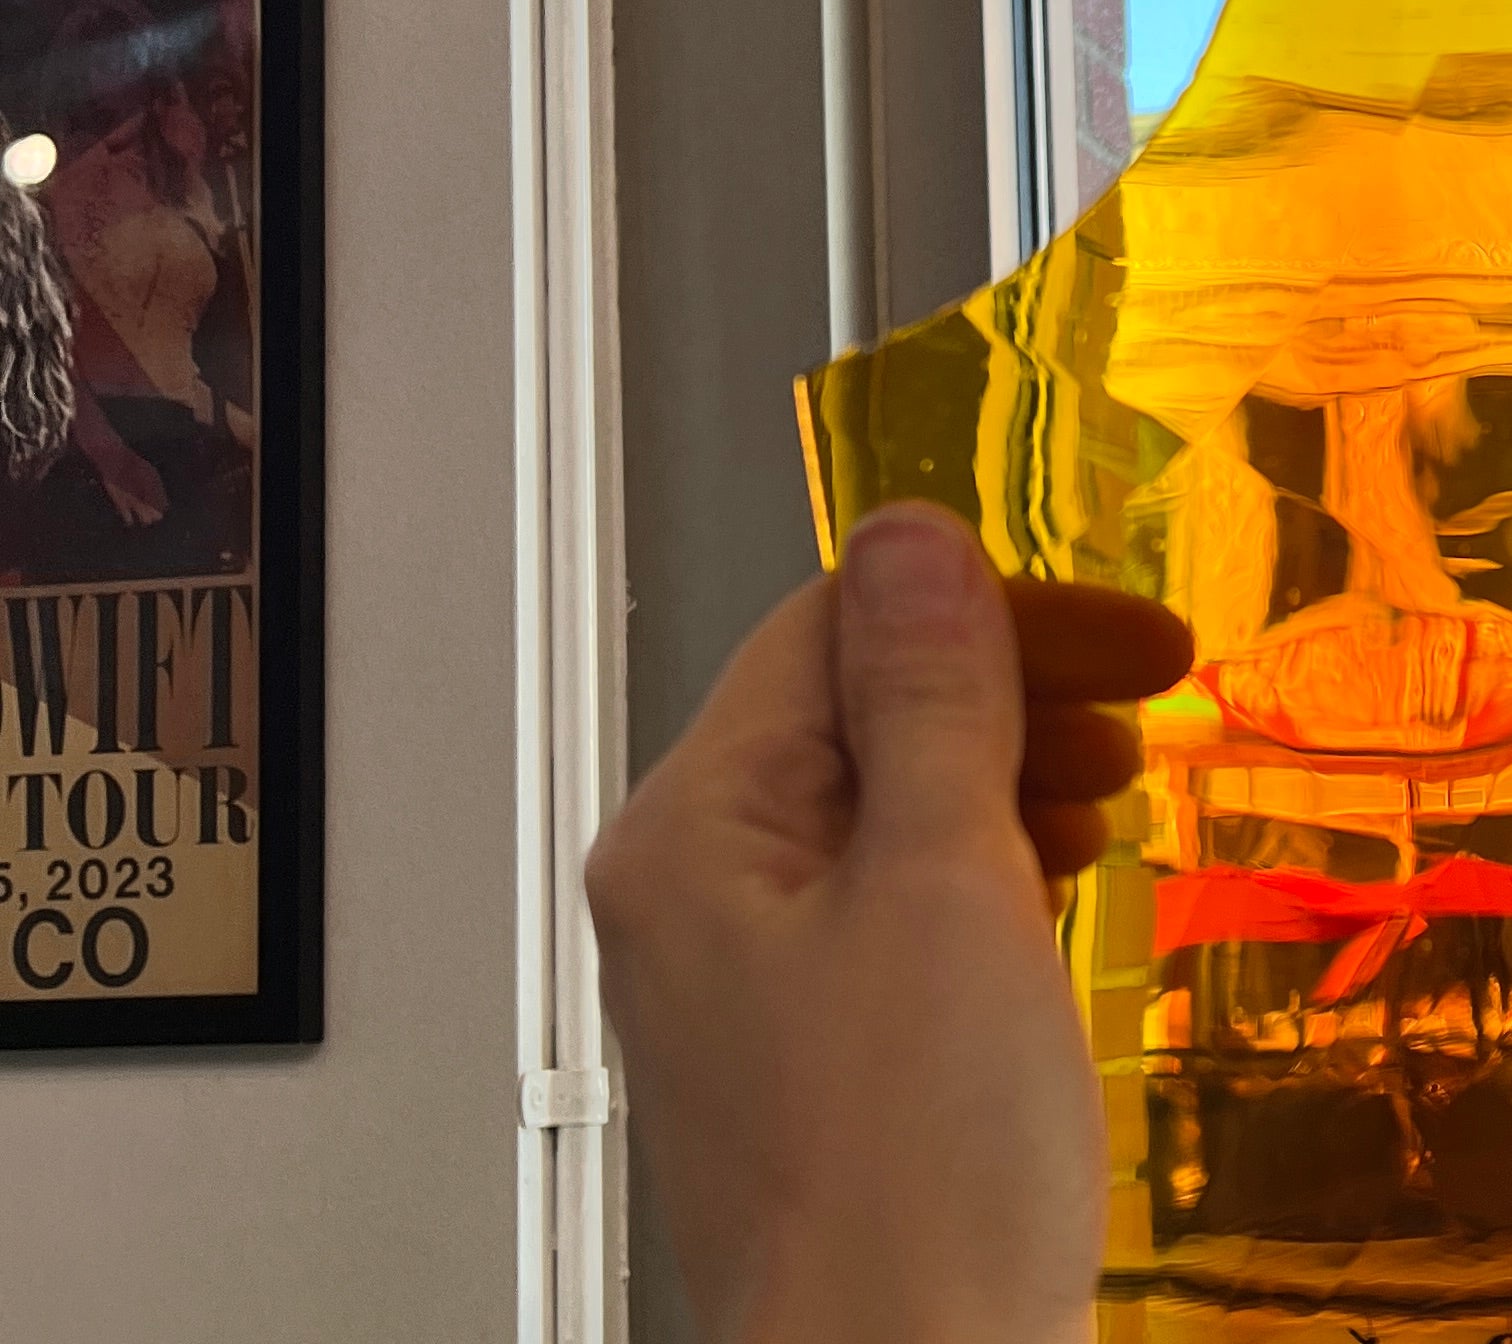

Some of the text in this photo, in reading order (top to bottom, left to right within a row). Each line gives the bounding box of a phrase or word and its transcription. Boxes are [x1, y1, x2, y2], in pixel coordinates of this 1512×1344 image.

[0, 585, 254, 757] WIFT
[6, 766, 255, 853] TOUR
[46, 856, 175, 901] 2023
[13, 906, 150, 990] CO
